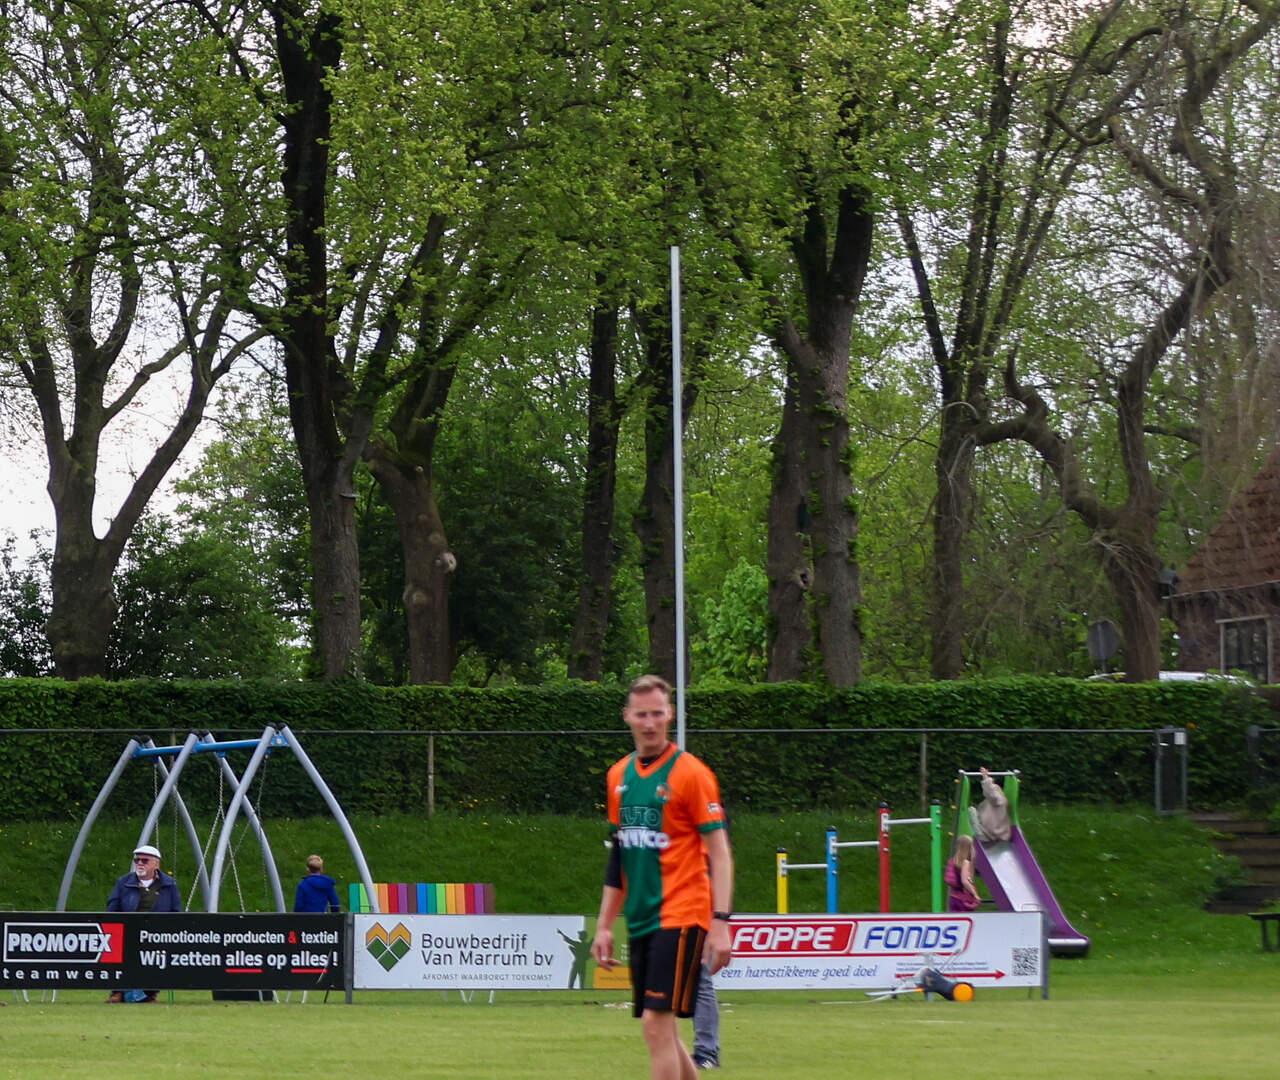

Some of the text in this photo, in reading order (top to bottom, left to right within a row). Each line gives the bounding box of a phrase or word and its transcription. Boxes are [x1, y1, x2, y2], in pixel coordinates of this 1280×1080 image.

[8, 933, 112, 953] PROMOTEX
[140, 930, 339, 946] Promotionele producten & textiel
[421, 933, 528, 951] Bouwbedrijf
[732, 926, 960, 951] FOPPE FONDS
[140, 951, 167, 969] Wij
[170, 951, 221, 966] zetten
[225, 951, 263, 966] alles
[267, 954, 287, 969] op
[291, 951, 328, 967] alles
[421, 950, 554, 966] Van Marrum bv
[3, 968, 123, 980] teamwear
[422, 973, 553, 981] AFKOMST WAARBORGT TOEKOMST
[721, 965, 878, 981] een hartstikkene goed doel
